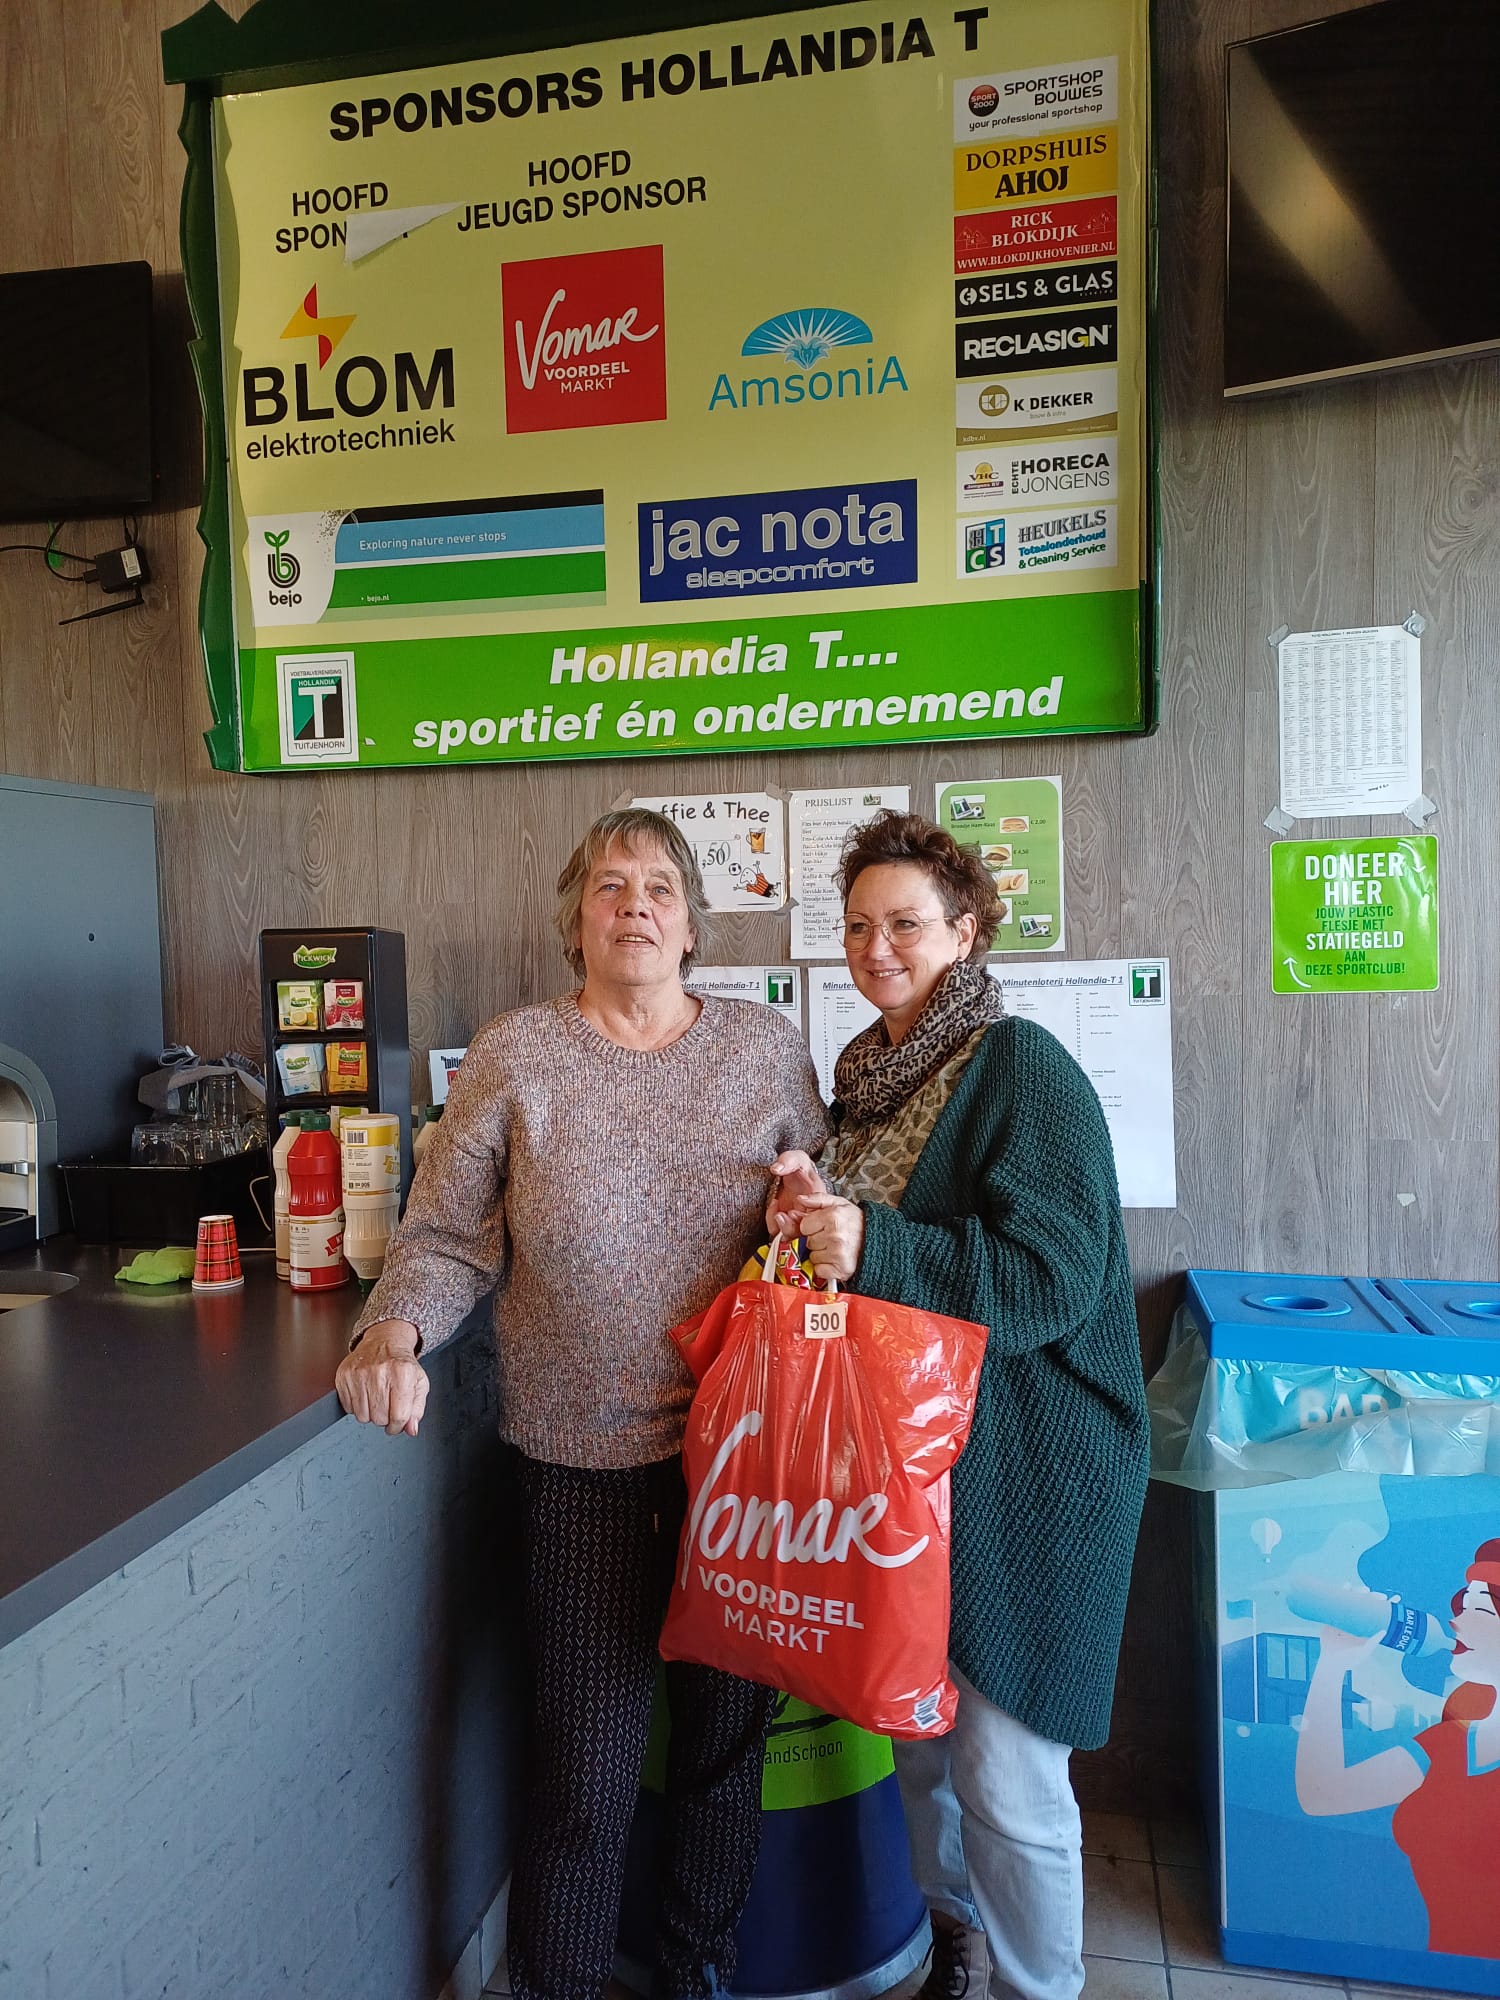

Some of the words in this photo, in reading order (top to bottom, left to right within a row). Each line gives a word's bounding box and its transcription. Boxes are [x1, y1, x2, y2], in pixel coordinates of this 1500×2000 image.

[330, 67, 601, 141] SPONSORS
[622, 17, 935, 102] HOLLANDIA
[954, 8, 989, 52] T
[1004, 70, 1103, 95] SPORTSHOP
[970, 93, 997, 102] SPORT
[973, 100, 995, 109] 2000
[1034, 85, 1103, 106] BOUWES
[969, 120, 989, 131] your
[992, 110, 1049, 128] professional
[1052, 103, 1102, 119] sportshop
[966, 134, 1107, 171] DORPSHUIS
[528, 150, 631, 187] HOOFD
[995, 166, 1069, 198] AHOJ
[292, 182, 388, 216] HOOFD
[457, 196, 553, 232] JEUGD
[563, 177, 707, 220] SPONSOR
[1011, 211, 1053, 228] RICK
[991, 224, 1079, 248] BLOKDIJK
[957, 241, 1115, 270] WWW.BLOKDIJKHOVENIER.NL
[1034, 278, 1048, 296] &
[1055, 270, 1113, 294] GLAS
[964, 325, 1109, 360] RECLASIGN
[544, 361, 630, 381] VOORDEEL
[243, 348, 455, 427] BLOM
[561, 377, 614, 394] MARKT
[247, 418, 456, 460] elektrotechniek
[969, 472, 999, 481] VHC
[1021, 453, 1110, 475] HORECA
[1021, 471, 1110, 494] JONGENS
[650, 509, 741, 576] jac
[762, 494, 904, 553] nota
[1018, 510, 1107, 543] HEUKELS
[359, 539, 407, 552] Exploring
[411, 537, 444, 547] nature
[447, 534, 474, 544] never
[478, 531, 506, 545] stops
[1018, 529, 1106, 557] Totaalonderhoud
[1018, 560, 1026, 569] &
[1027, 550, 1069, 568] Cleaning
[1071, 543, 1106, 558] Service
[686, 557, 874, 588] slaapcomfort
[269, 591, 302, 607] bejo
[366, 593, 390, 603] bejo.nl
[549, 635, 788, 684] Hollandia
[809, 630, 898, 669] T....
[298, 686, 337, 738] T
[413, 702, 602, 755] sportief
[616, 700, 676, 737] én
[693, 676, 1063, 735] ondernemend
[294, 741, 345, 750] TUITJENHORN
[661, 803, 696, 822] ffie
[703, 801, 715, 819] &
[723, 802, 770, 823] Thee
[805, 797, 853, 807] PRIJSLIJST
[1305, 852, 1405, 880] DONEER
[1324, 880, 1382, 906] HIER
[1315, 907, 1345, 919] JOUW
[1349, 905, 1394, 917] PLASTIC
[1322, 919, 1358, 931] FLESJE
[1362, 919, 1384, 930] MET
[1306, 931, 1404, 950] STATIEGELD
[296, 952, 333, 963] PICKWICK
[1305, 964, 1332, 975] DEZE
[1336, 962, 1405, 975] SPORTCLUB!
[1344, 951, 1365, 962] AAN
[1002, 978, 1064, 987] Minutenloterij
[810, 1313, 840, 1331] 500
[697, 1565, 864, 1630] VOORDEEL
[723, 1604, 830, 1654] MARKT
[764, 1740, 843, 1765] andSchoon
